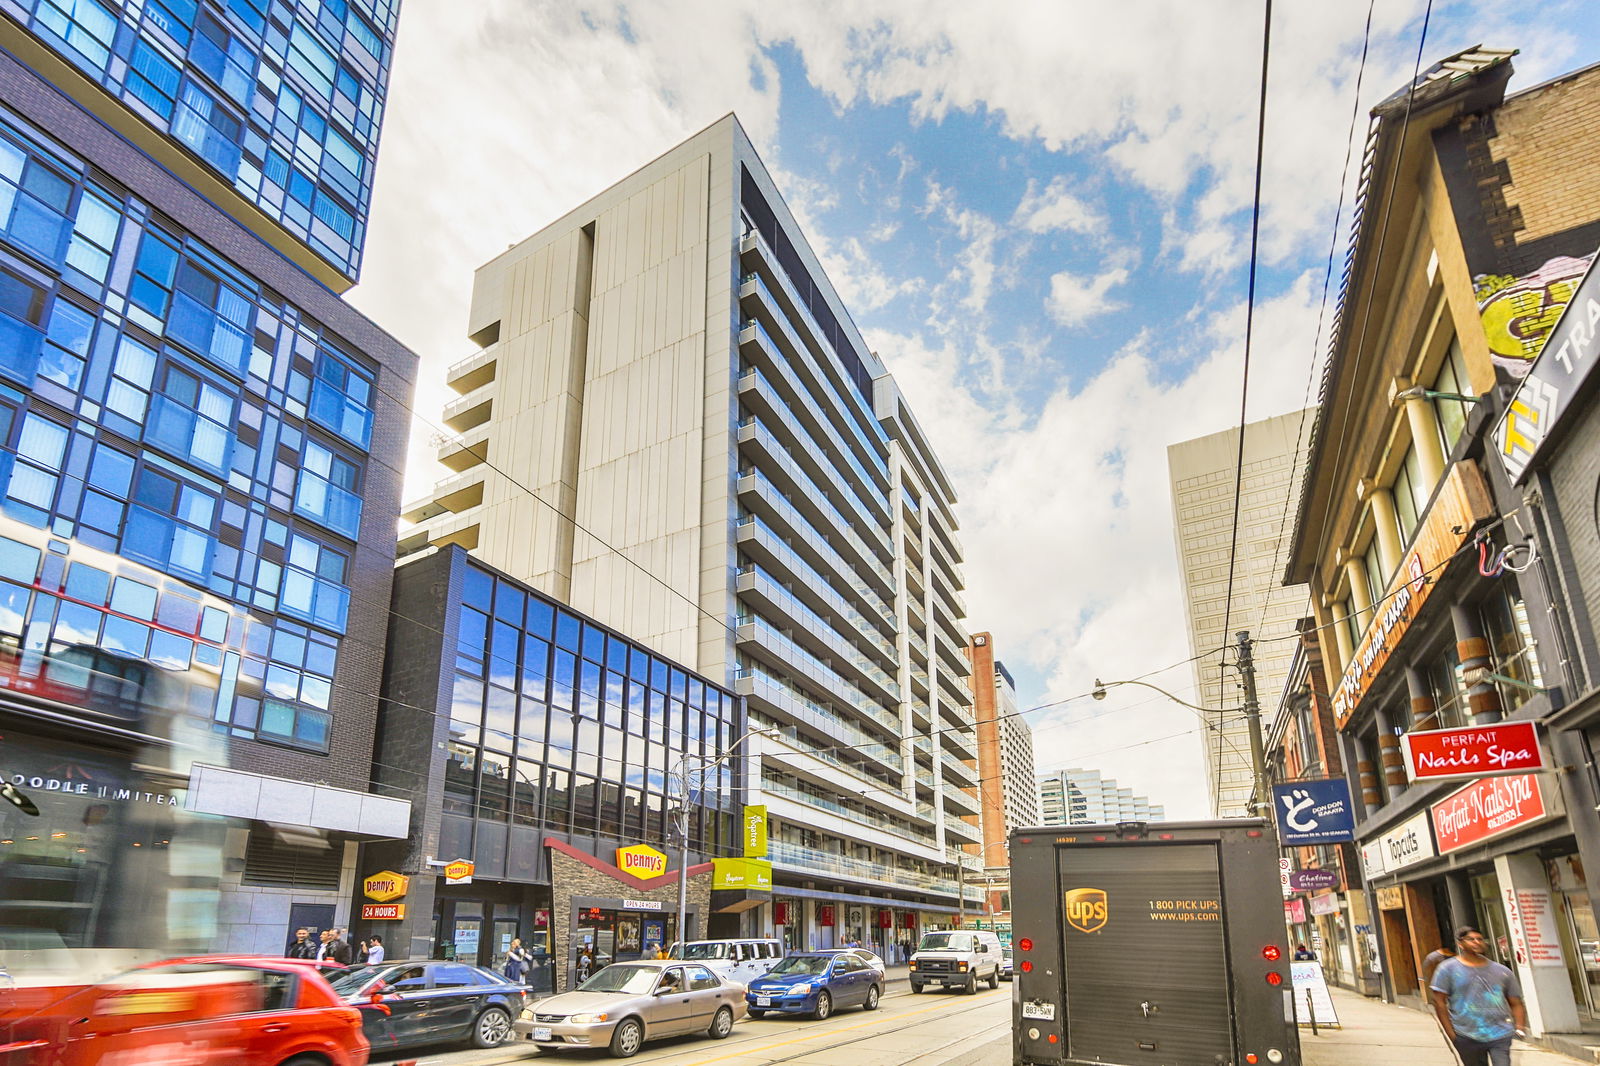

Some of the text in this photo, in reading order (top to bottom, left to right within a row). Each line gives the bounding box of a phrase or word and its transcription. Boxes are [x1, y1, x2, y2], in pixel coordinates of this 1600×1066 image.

[1441, 732, 1497, 747] PERFAIT
[1419, 745, 1532, 769] Nails Spa
[0, 774, 89, 794] OODLE
[118, 789, 178, 806] MITEA
[1312, 800, 1343, 814] DON DON
[1438, 775, 1532, 842] Perfait Nails Spa
[1387, 828, 1419, 864] Topcuts
[625, 852, 662, 871] Denny's
[448, 866, 467, 875] Denny's
[1299, 874, 1333, 882] Chatime
[366, 879, 395, 893] Denny's
[365, 907, 397, 917] 24 HOURS
[1149, 901, 1219, 910] 1 800 PICK UPS
[1069, 901, 1105, 926] ups
[1150, 912, 1219, 922] www.ups.com
